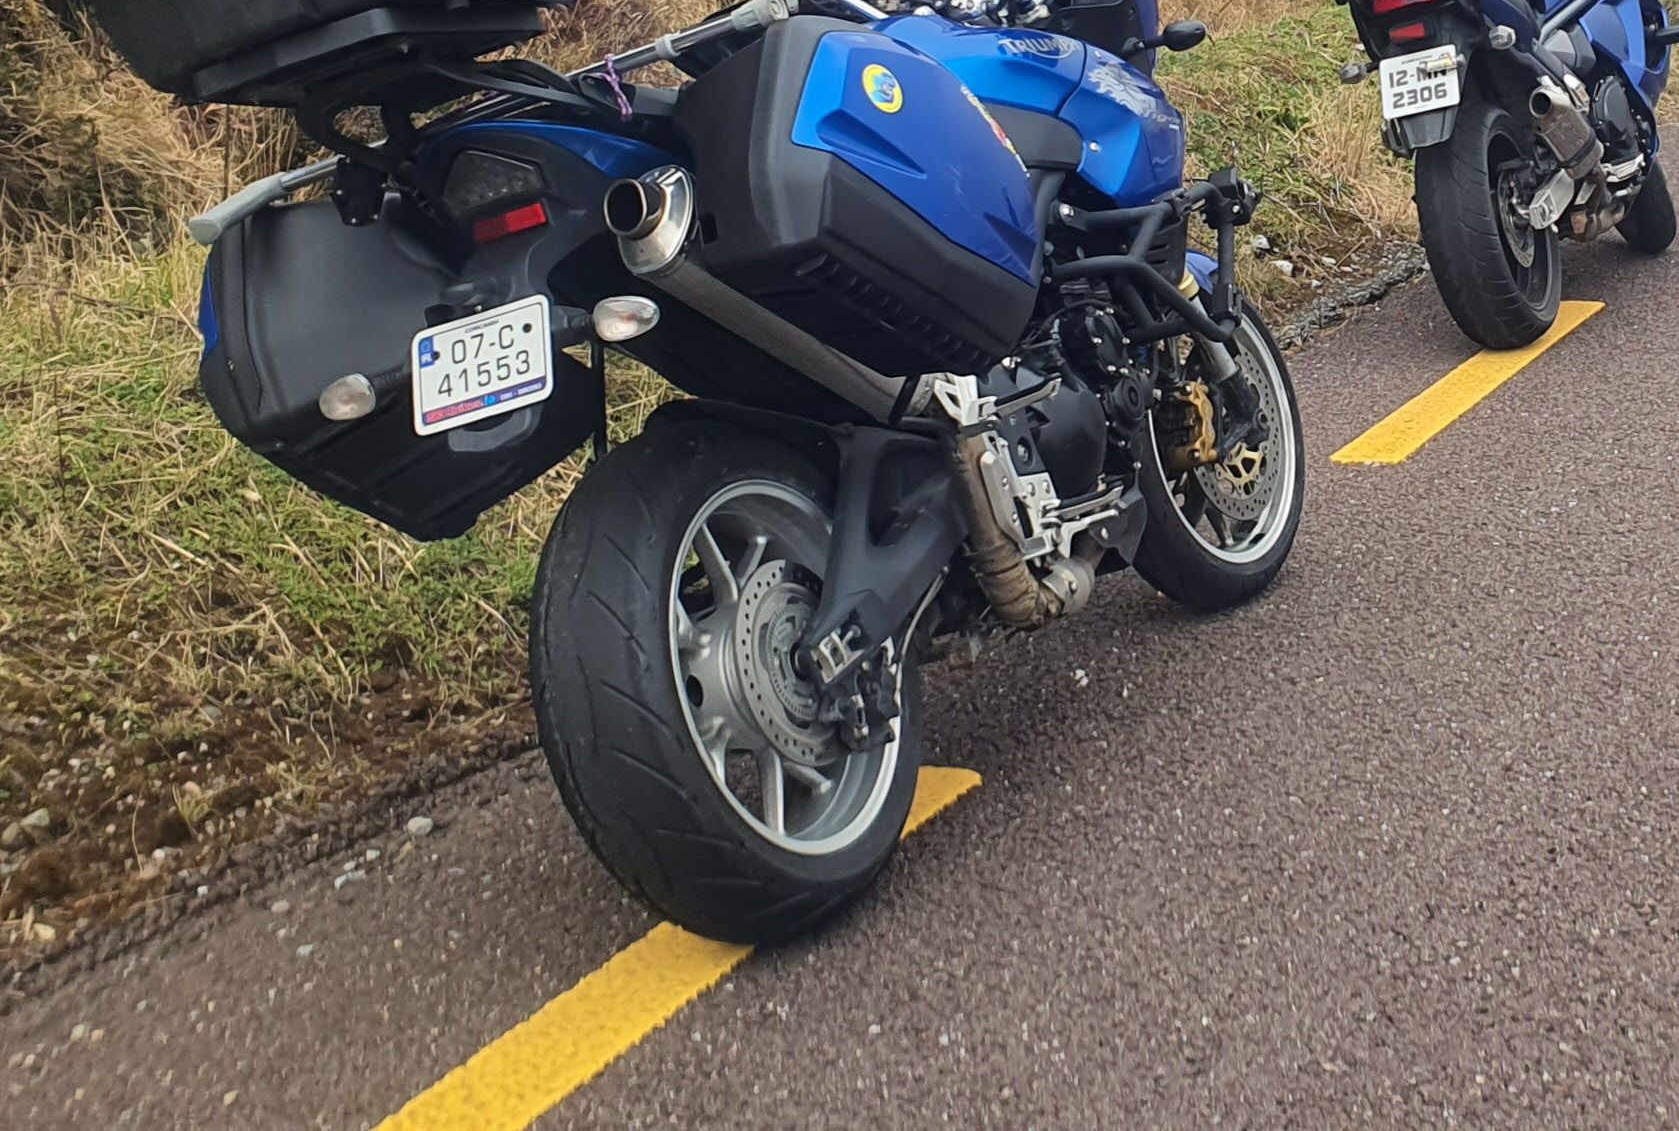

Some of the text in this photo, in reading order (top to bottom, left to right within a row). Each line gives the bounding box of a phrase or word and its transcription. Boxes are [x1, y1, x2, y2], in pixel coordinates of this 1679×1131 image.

[998, 37, 1079, 58] TRIUMPH
[1392, 82, 1448, 110] 2306
[451, 324, 515, 365] 07-C
[437, 349, 531, 398] 41553
